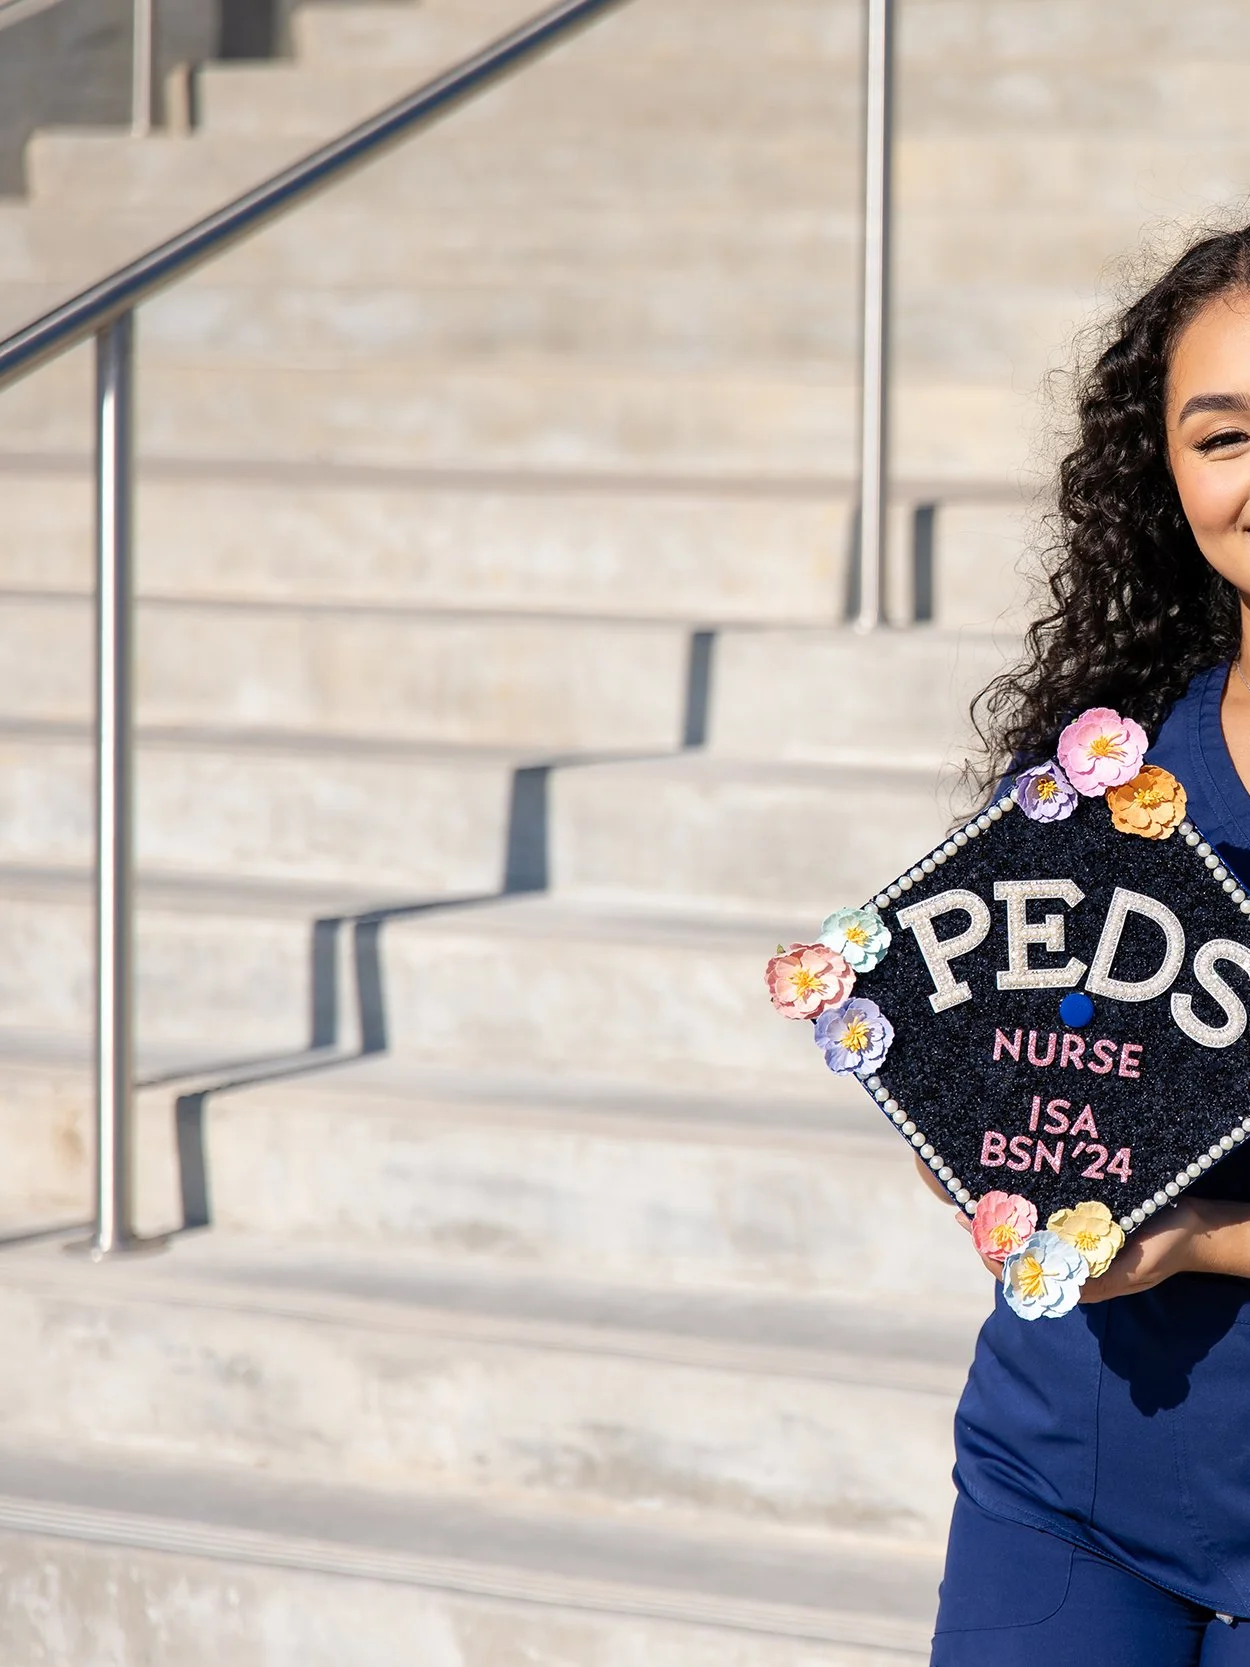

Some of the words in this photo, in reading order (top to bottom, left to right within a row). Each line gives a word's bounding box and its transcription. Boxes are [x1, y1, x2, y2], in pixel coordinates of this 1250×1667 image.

[992, 1028, 1144, 1079] NURSE
[1028, 1095, 1099, 1139] ISA
[979, 1130, 1065, 1175] BSN
